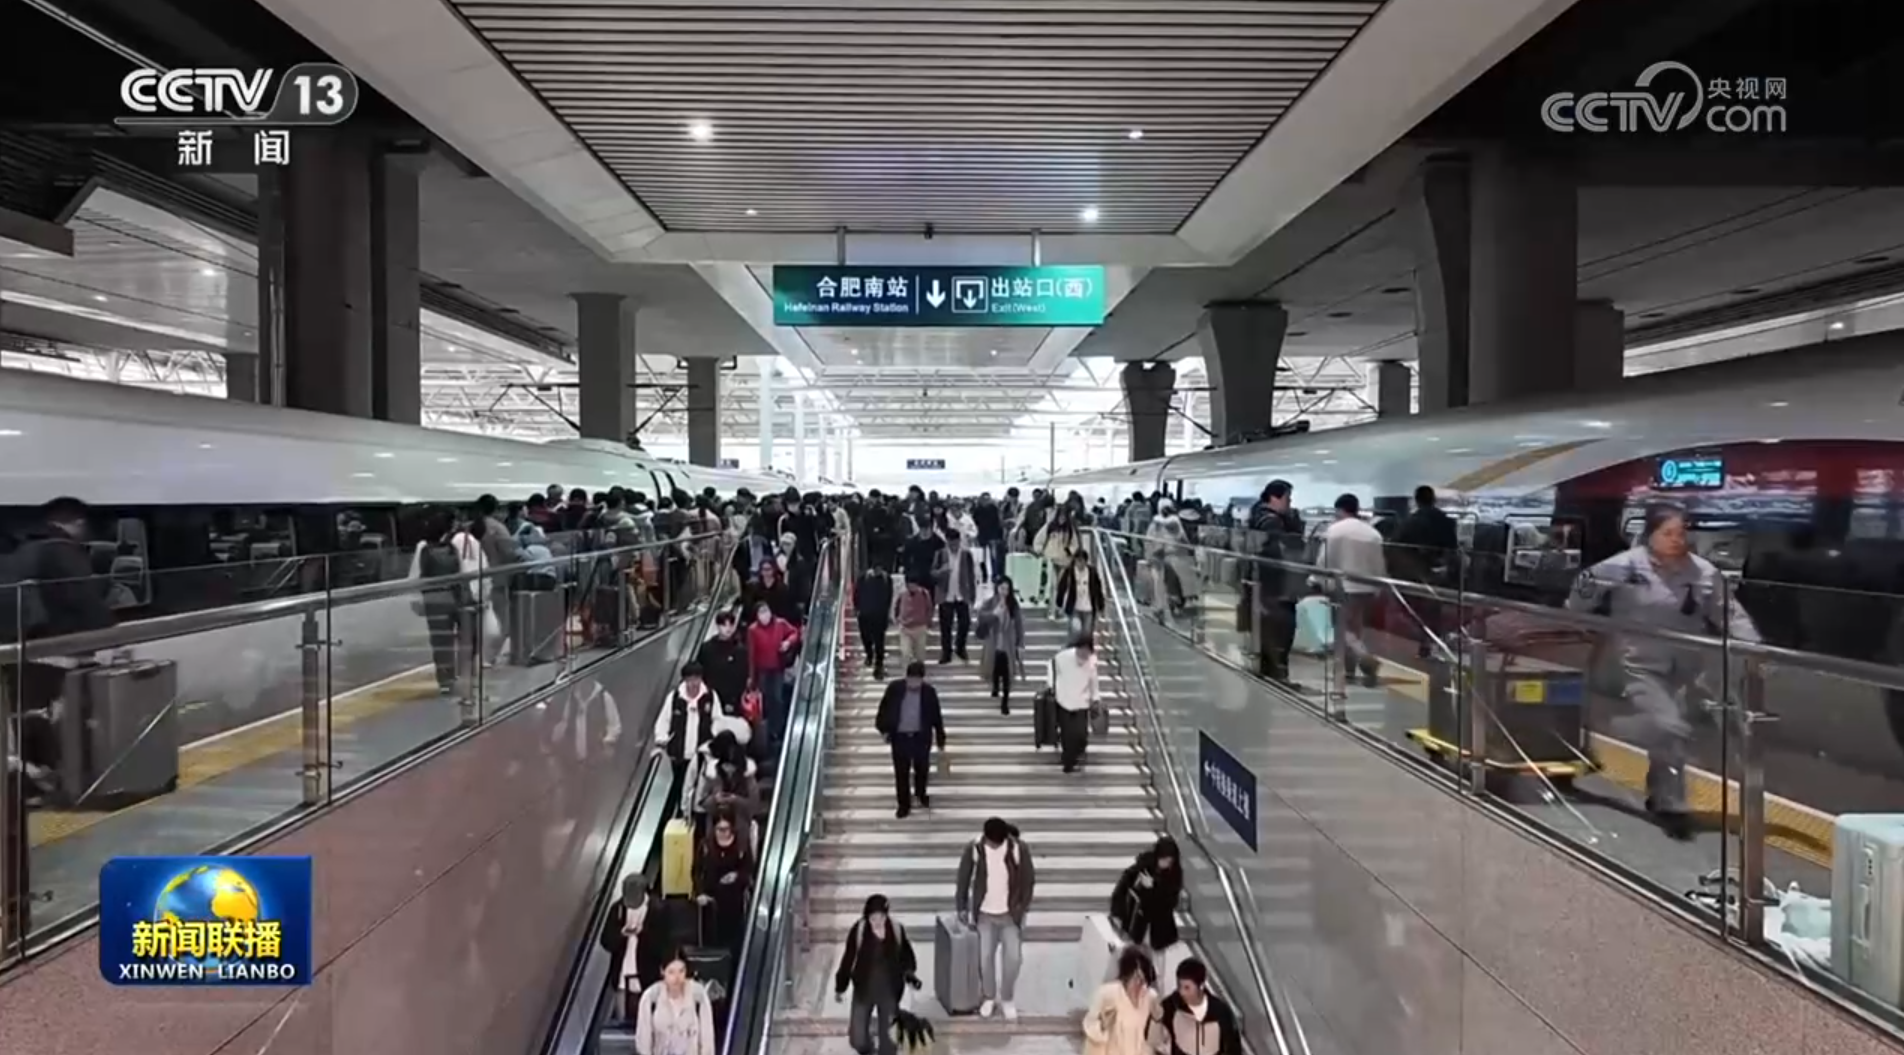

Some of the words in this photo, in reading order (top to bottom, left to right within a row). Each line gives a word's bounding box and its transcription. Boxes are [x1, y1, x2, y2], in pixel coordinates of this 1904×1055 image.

[816, 276, 909, 298] 合肥南站
[831, 303, 871, 314] Railway
[873, 303, 909, 312] Station
